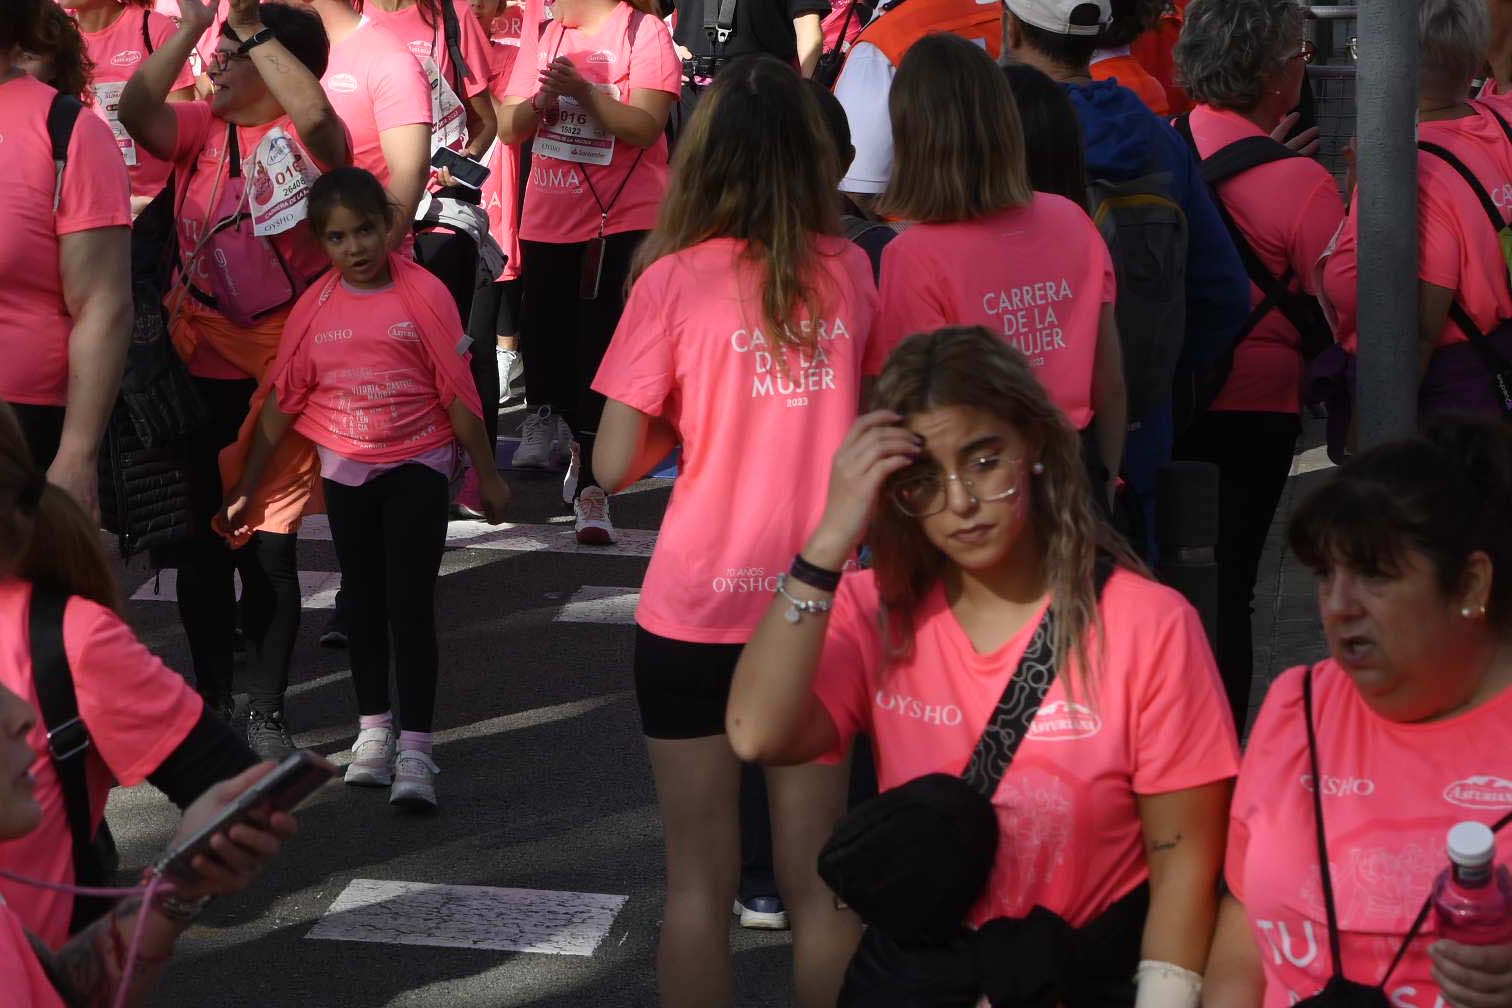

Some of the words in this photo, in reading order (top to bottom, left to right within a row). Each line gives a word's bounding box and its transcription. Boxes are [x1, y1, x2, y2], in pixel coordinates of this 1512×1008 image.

[560, 110, 587, 125] 016
[533, 166, 580, 188] SUMA
[983, 278, 1073, 316] CARRERA
[1003, 311, 1028, 336] DE
[1035, 307, 1058, 329] LA
[315, 328, 353, 345] OYSHO
[751, 367, 836, 398] MUJER
[786, 397, 808, 408] 2023
[1255, 918, 1318, 968] TU
